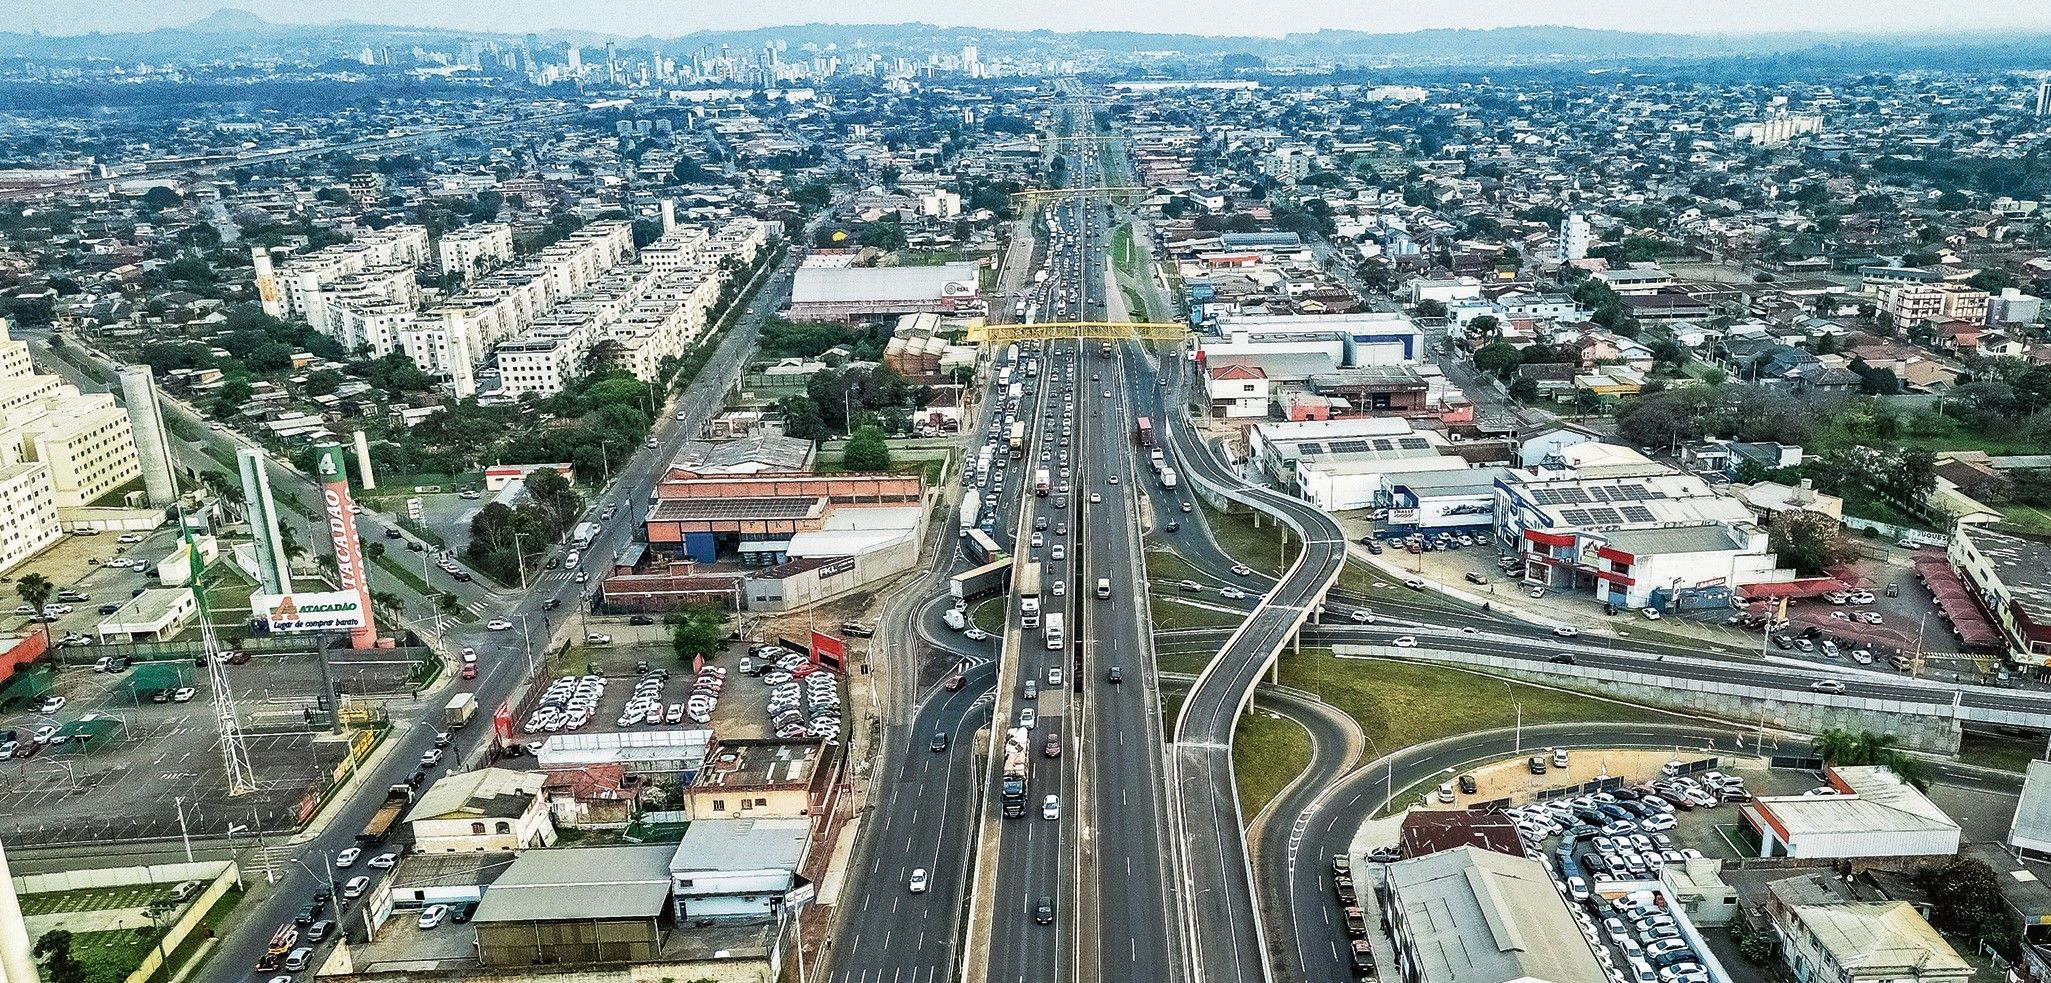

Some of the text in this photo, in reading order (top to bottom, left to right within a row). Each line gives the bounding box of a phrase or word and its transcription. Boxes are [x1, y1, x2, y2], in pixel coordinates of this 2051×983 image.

[820, 565, 838, 577] FKL
[273, 618, 359, 630] Lugar de comprar barato
